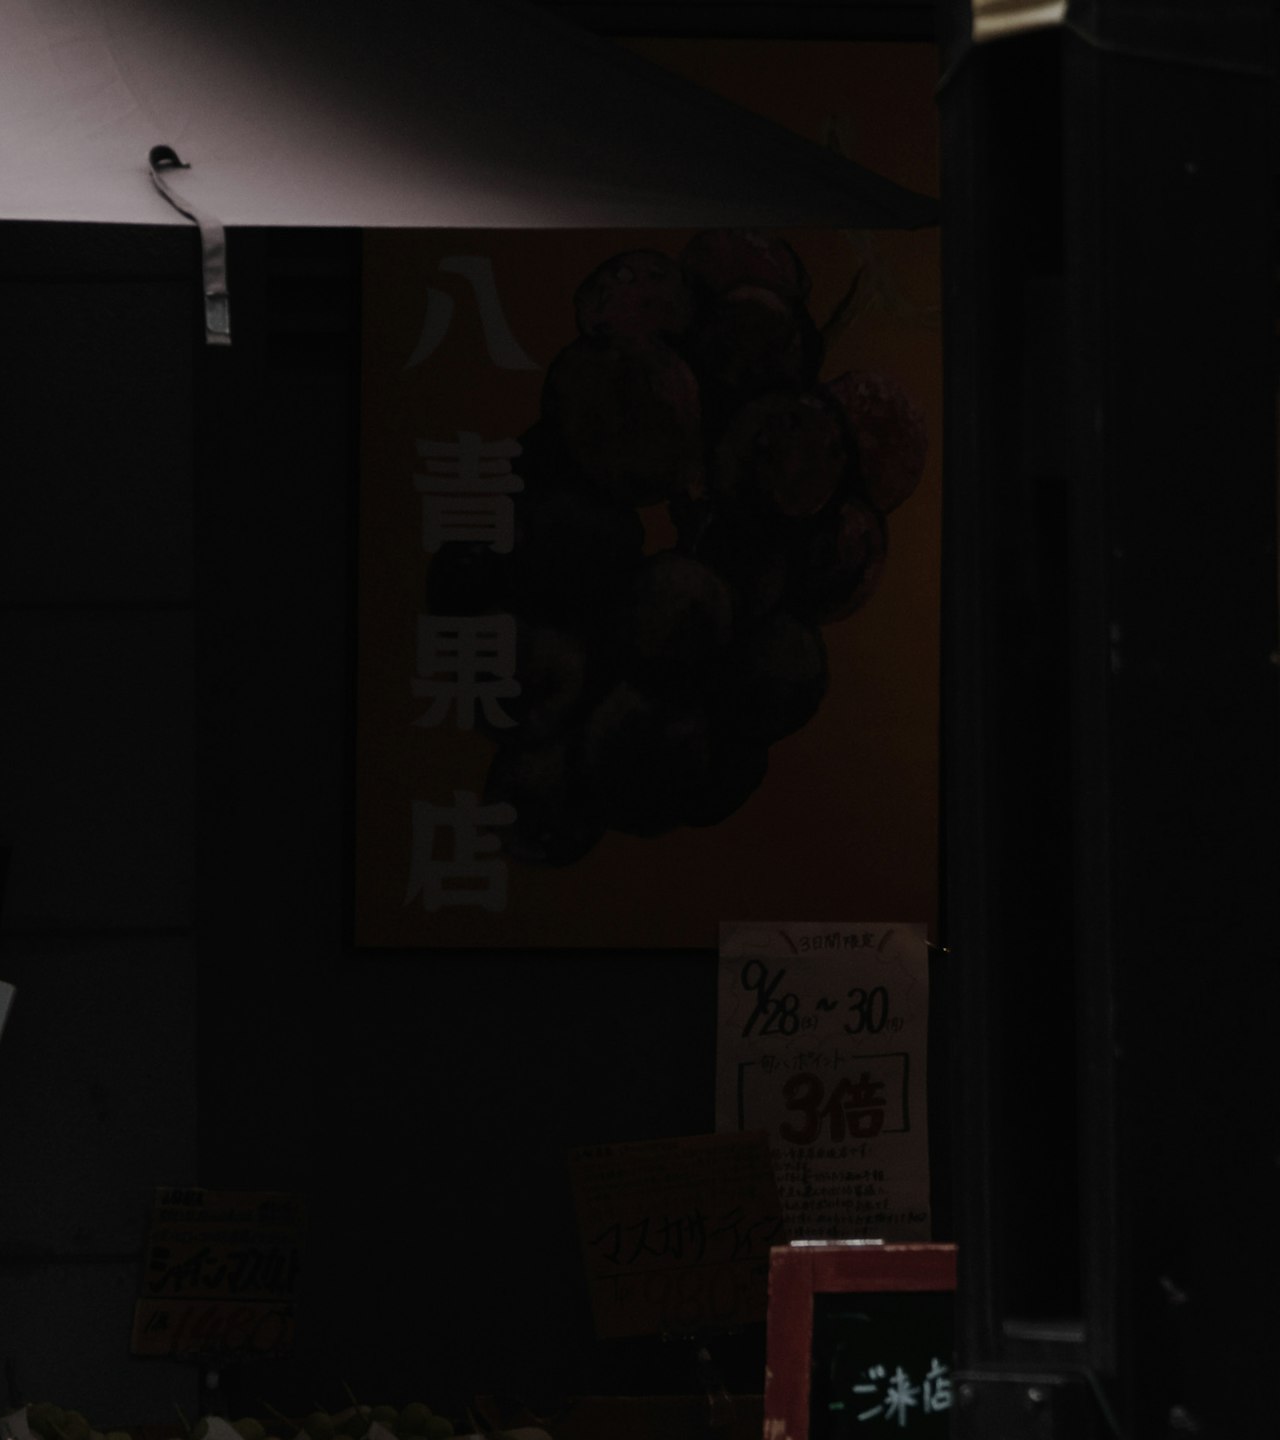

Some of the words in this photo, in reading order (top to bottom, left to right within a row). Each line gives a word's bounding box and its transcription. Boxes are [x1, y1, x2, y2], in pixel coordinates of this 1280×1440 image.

[402, 255, 542, 914] 八青果店
[779, 1071, 887, 1145] 3倍
